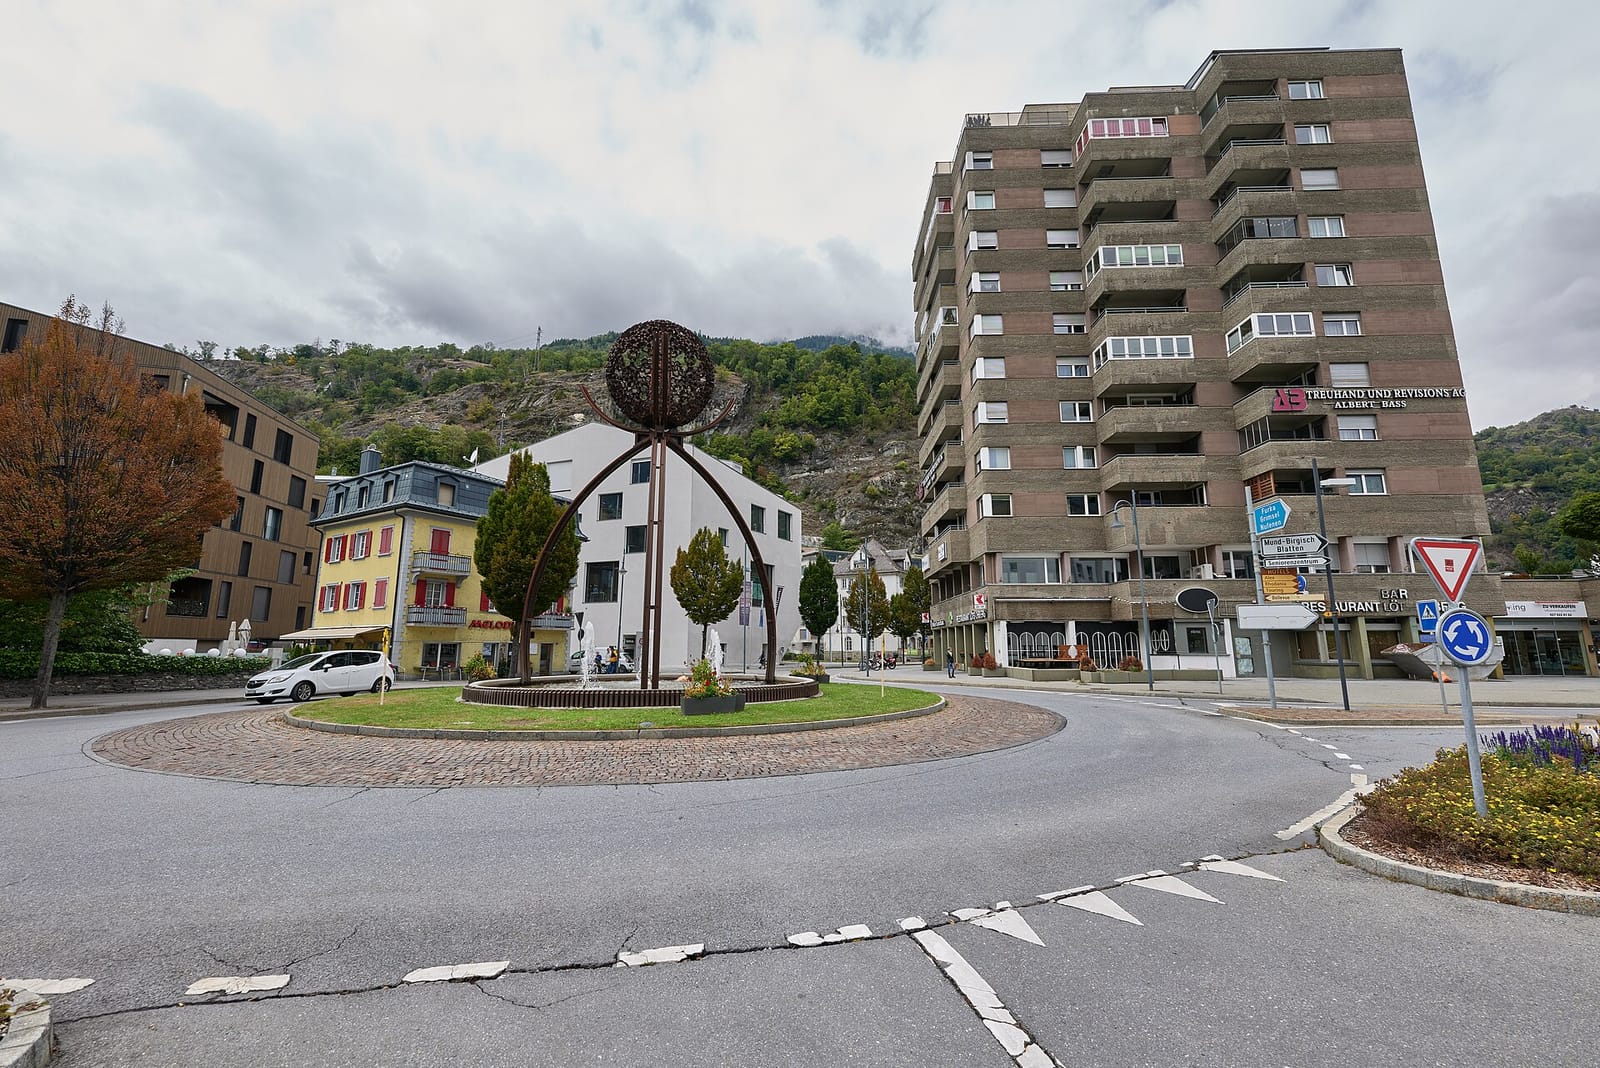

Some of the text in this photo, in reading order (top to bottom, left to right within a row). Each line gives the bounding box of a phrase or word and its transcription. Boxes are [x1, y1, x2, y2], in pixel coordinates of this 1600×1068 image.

[1306, 388, 1466, 399] TREUHAND UND REVISIONS AG
[1334, 400, 1407, 409] ALBERT BASS
[1261, 505, 1276, 515] Furka
[1260, 520, 1282, 531] Nufenen
[1264, 536, 1315, 547] Mund-Birgisch
[1277, 545, 1304, 553] Blatten
[1268, 558, 1319, 566] Seniorenzentrum
[1381, 589, 1408, 599] BAR
[1301, 601, 1381, 612] RESAURANT
[468, 619, 514, 630] MELOD
